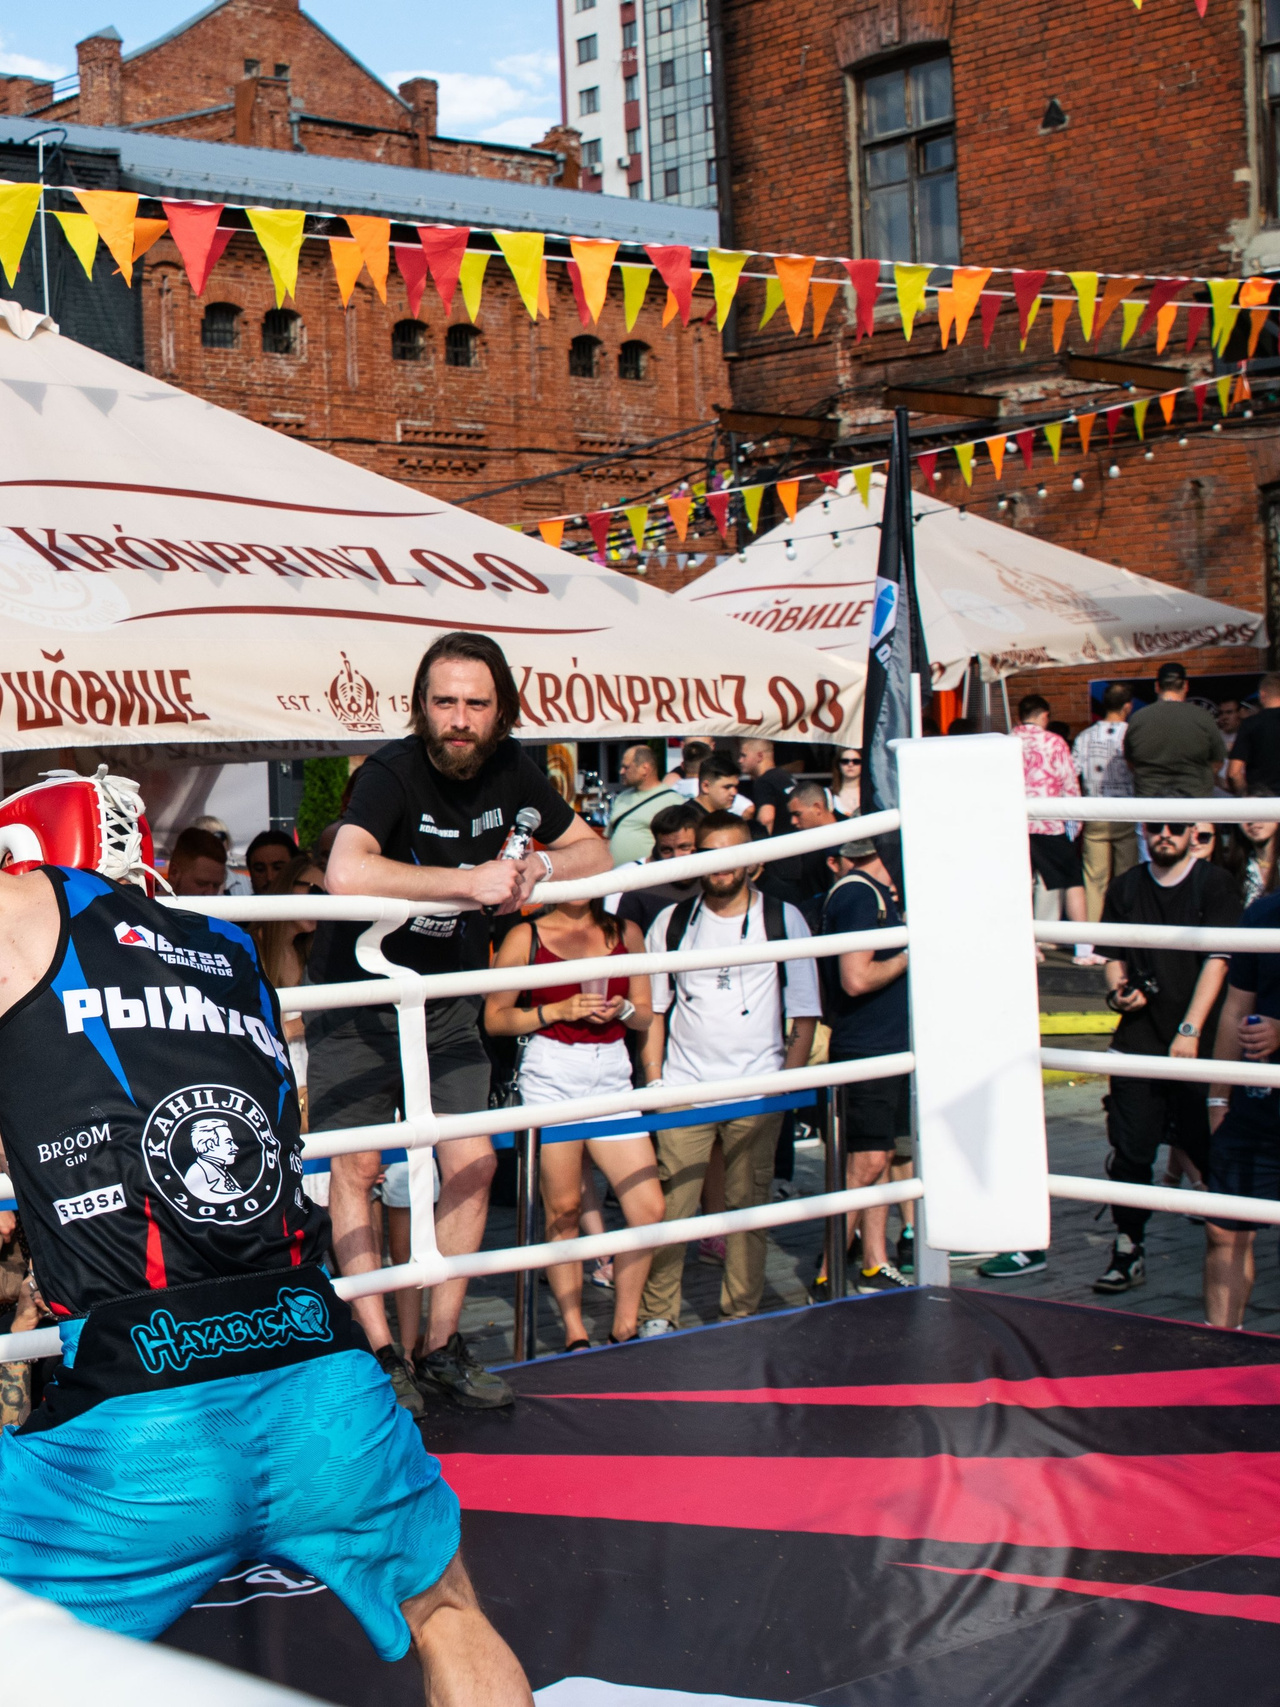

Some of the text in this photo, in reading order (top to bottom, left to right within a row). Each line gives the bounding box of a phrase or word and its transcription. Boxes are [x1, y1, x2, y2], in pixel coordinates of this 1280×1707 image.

[409, 547, 549, 595] 0.0
[276, 695, 322, 713] EST.
[37, 1122, 112, 1164] BROOM
[148, 1089, 278, 1170] КАНЦЛЕРЪ
[65, 1152, 88, 1168] GIN
[58, 1189, 124, 1218] SIBSA
[174, 1192, 260, 1218] 2010
[137, 1312, 305, 1367] HAYABUSA
